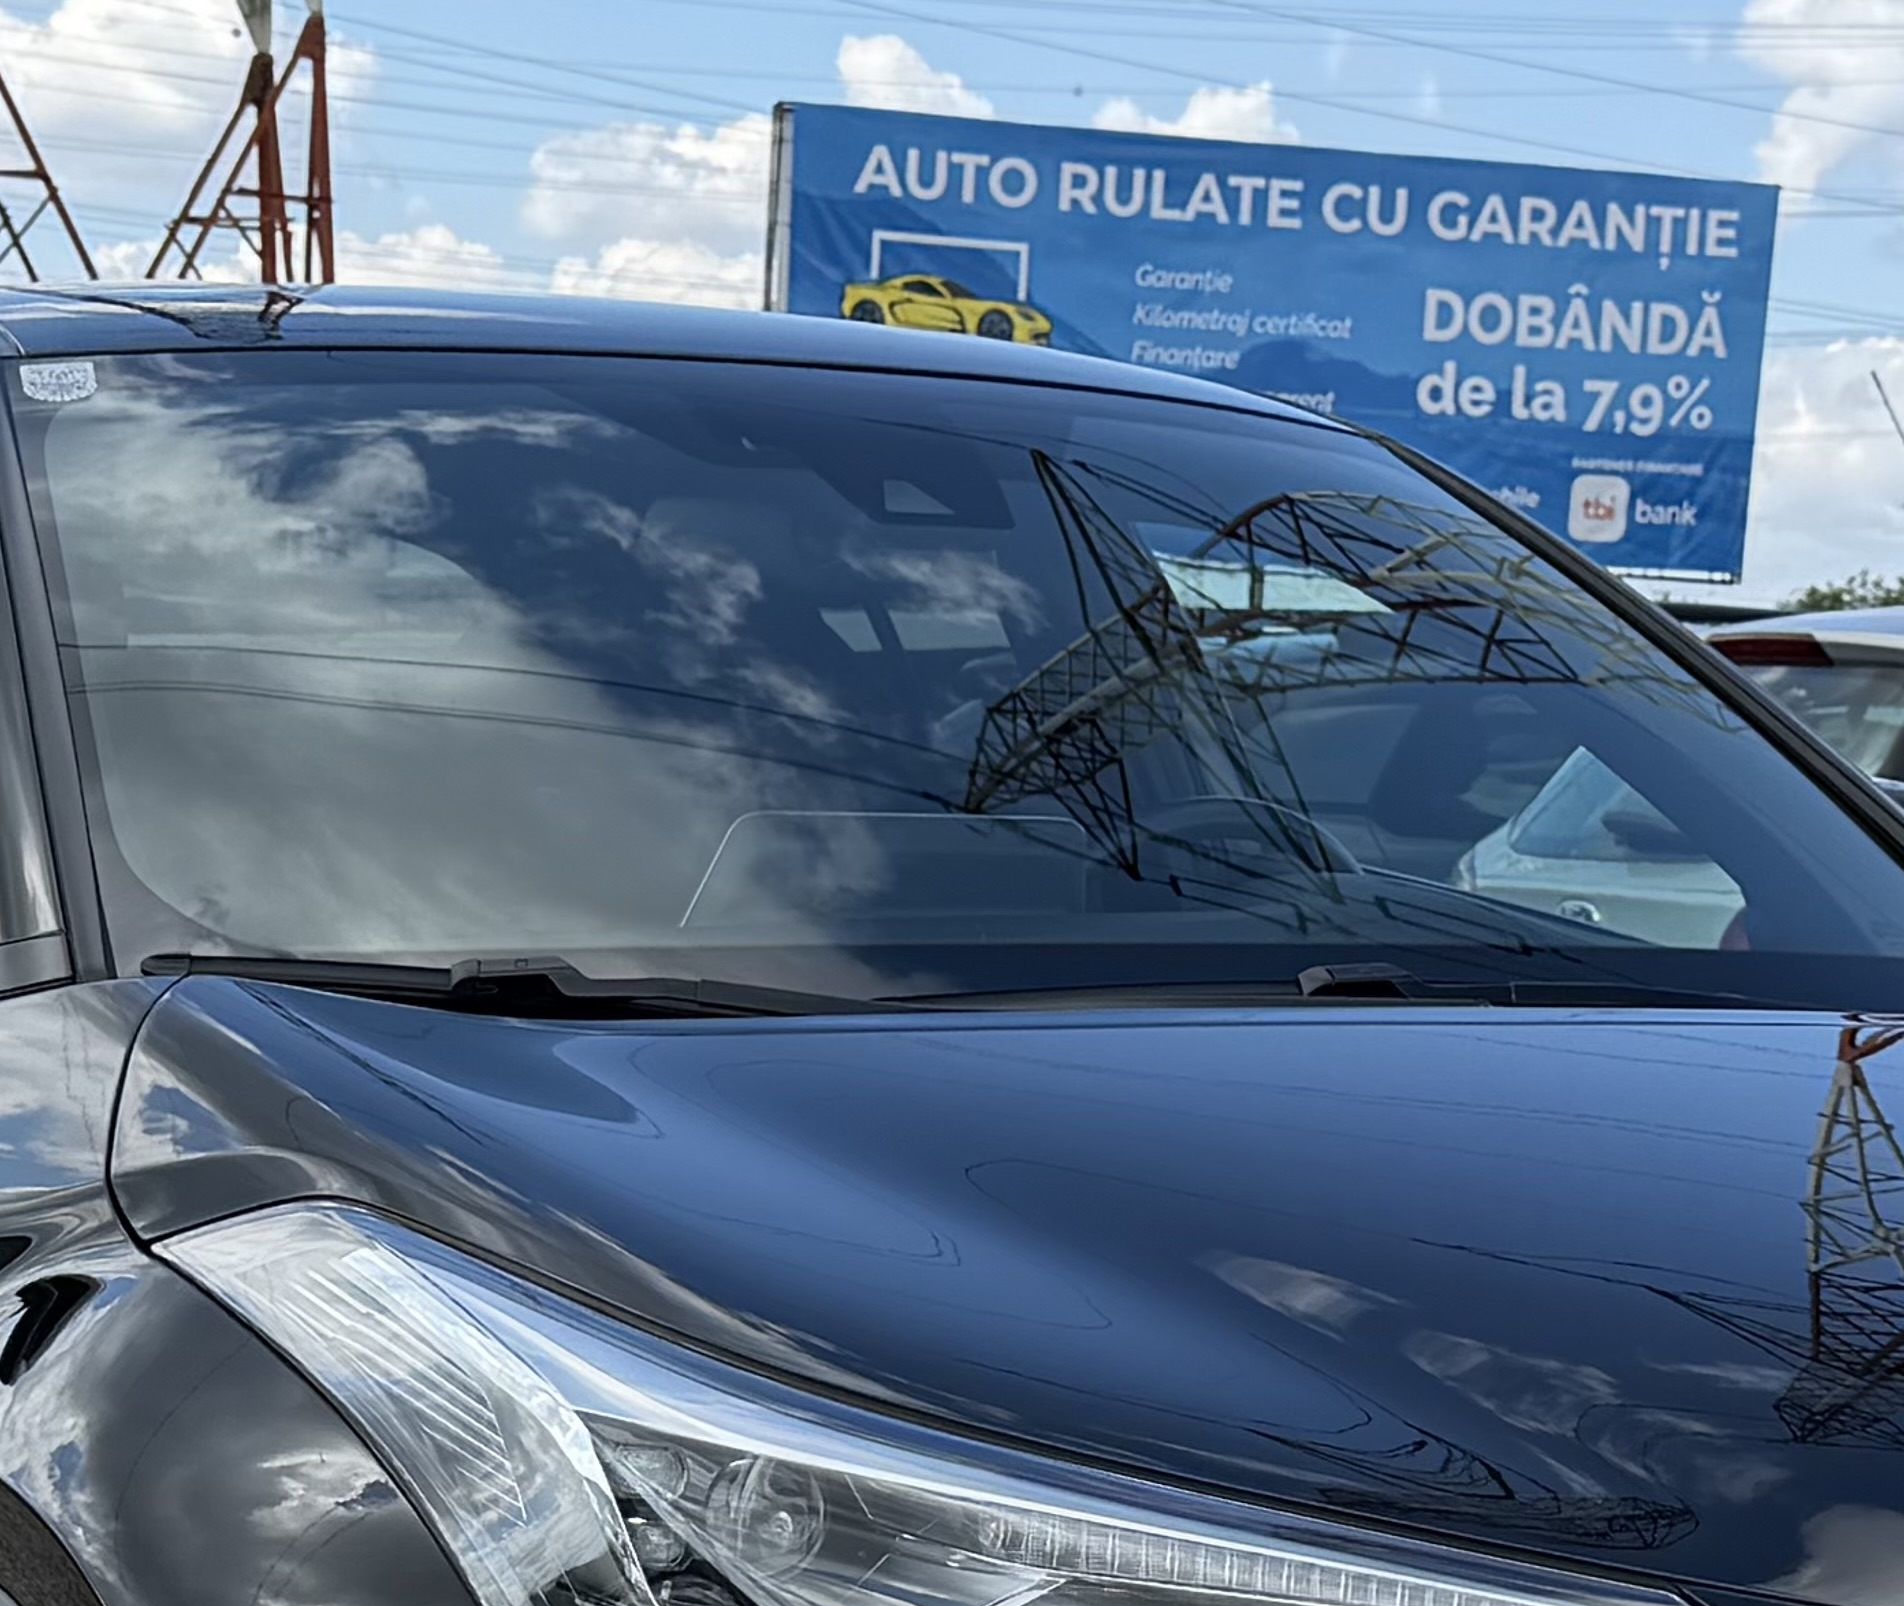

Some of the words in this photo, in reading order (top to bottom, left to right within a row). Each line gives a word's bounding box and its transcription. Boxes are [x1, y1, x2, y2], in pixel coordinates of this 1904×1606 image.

[855, 146, 1037, 207] AUTO
[1059, 163, 1304, 228] RULATE
[1323, 184, 1407, 236] CU
[1133, 303, 1250, 336] Kilometraj
[1253, 312, 1352, 339] certificat
[1424, 284, 1727, 358] DOBÂNDĂ
[1418, 361, 1494, 416] de
[1512, 365, 1565, 421] la
[1584, 377, 1712, 436] 7,9%
[1583, 494, 1616, 521] tbi
[1634, 498, 1697, 526] bank
